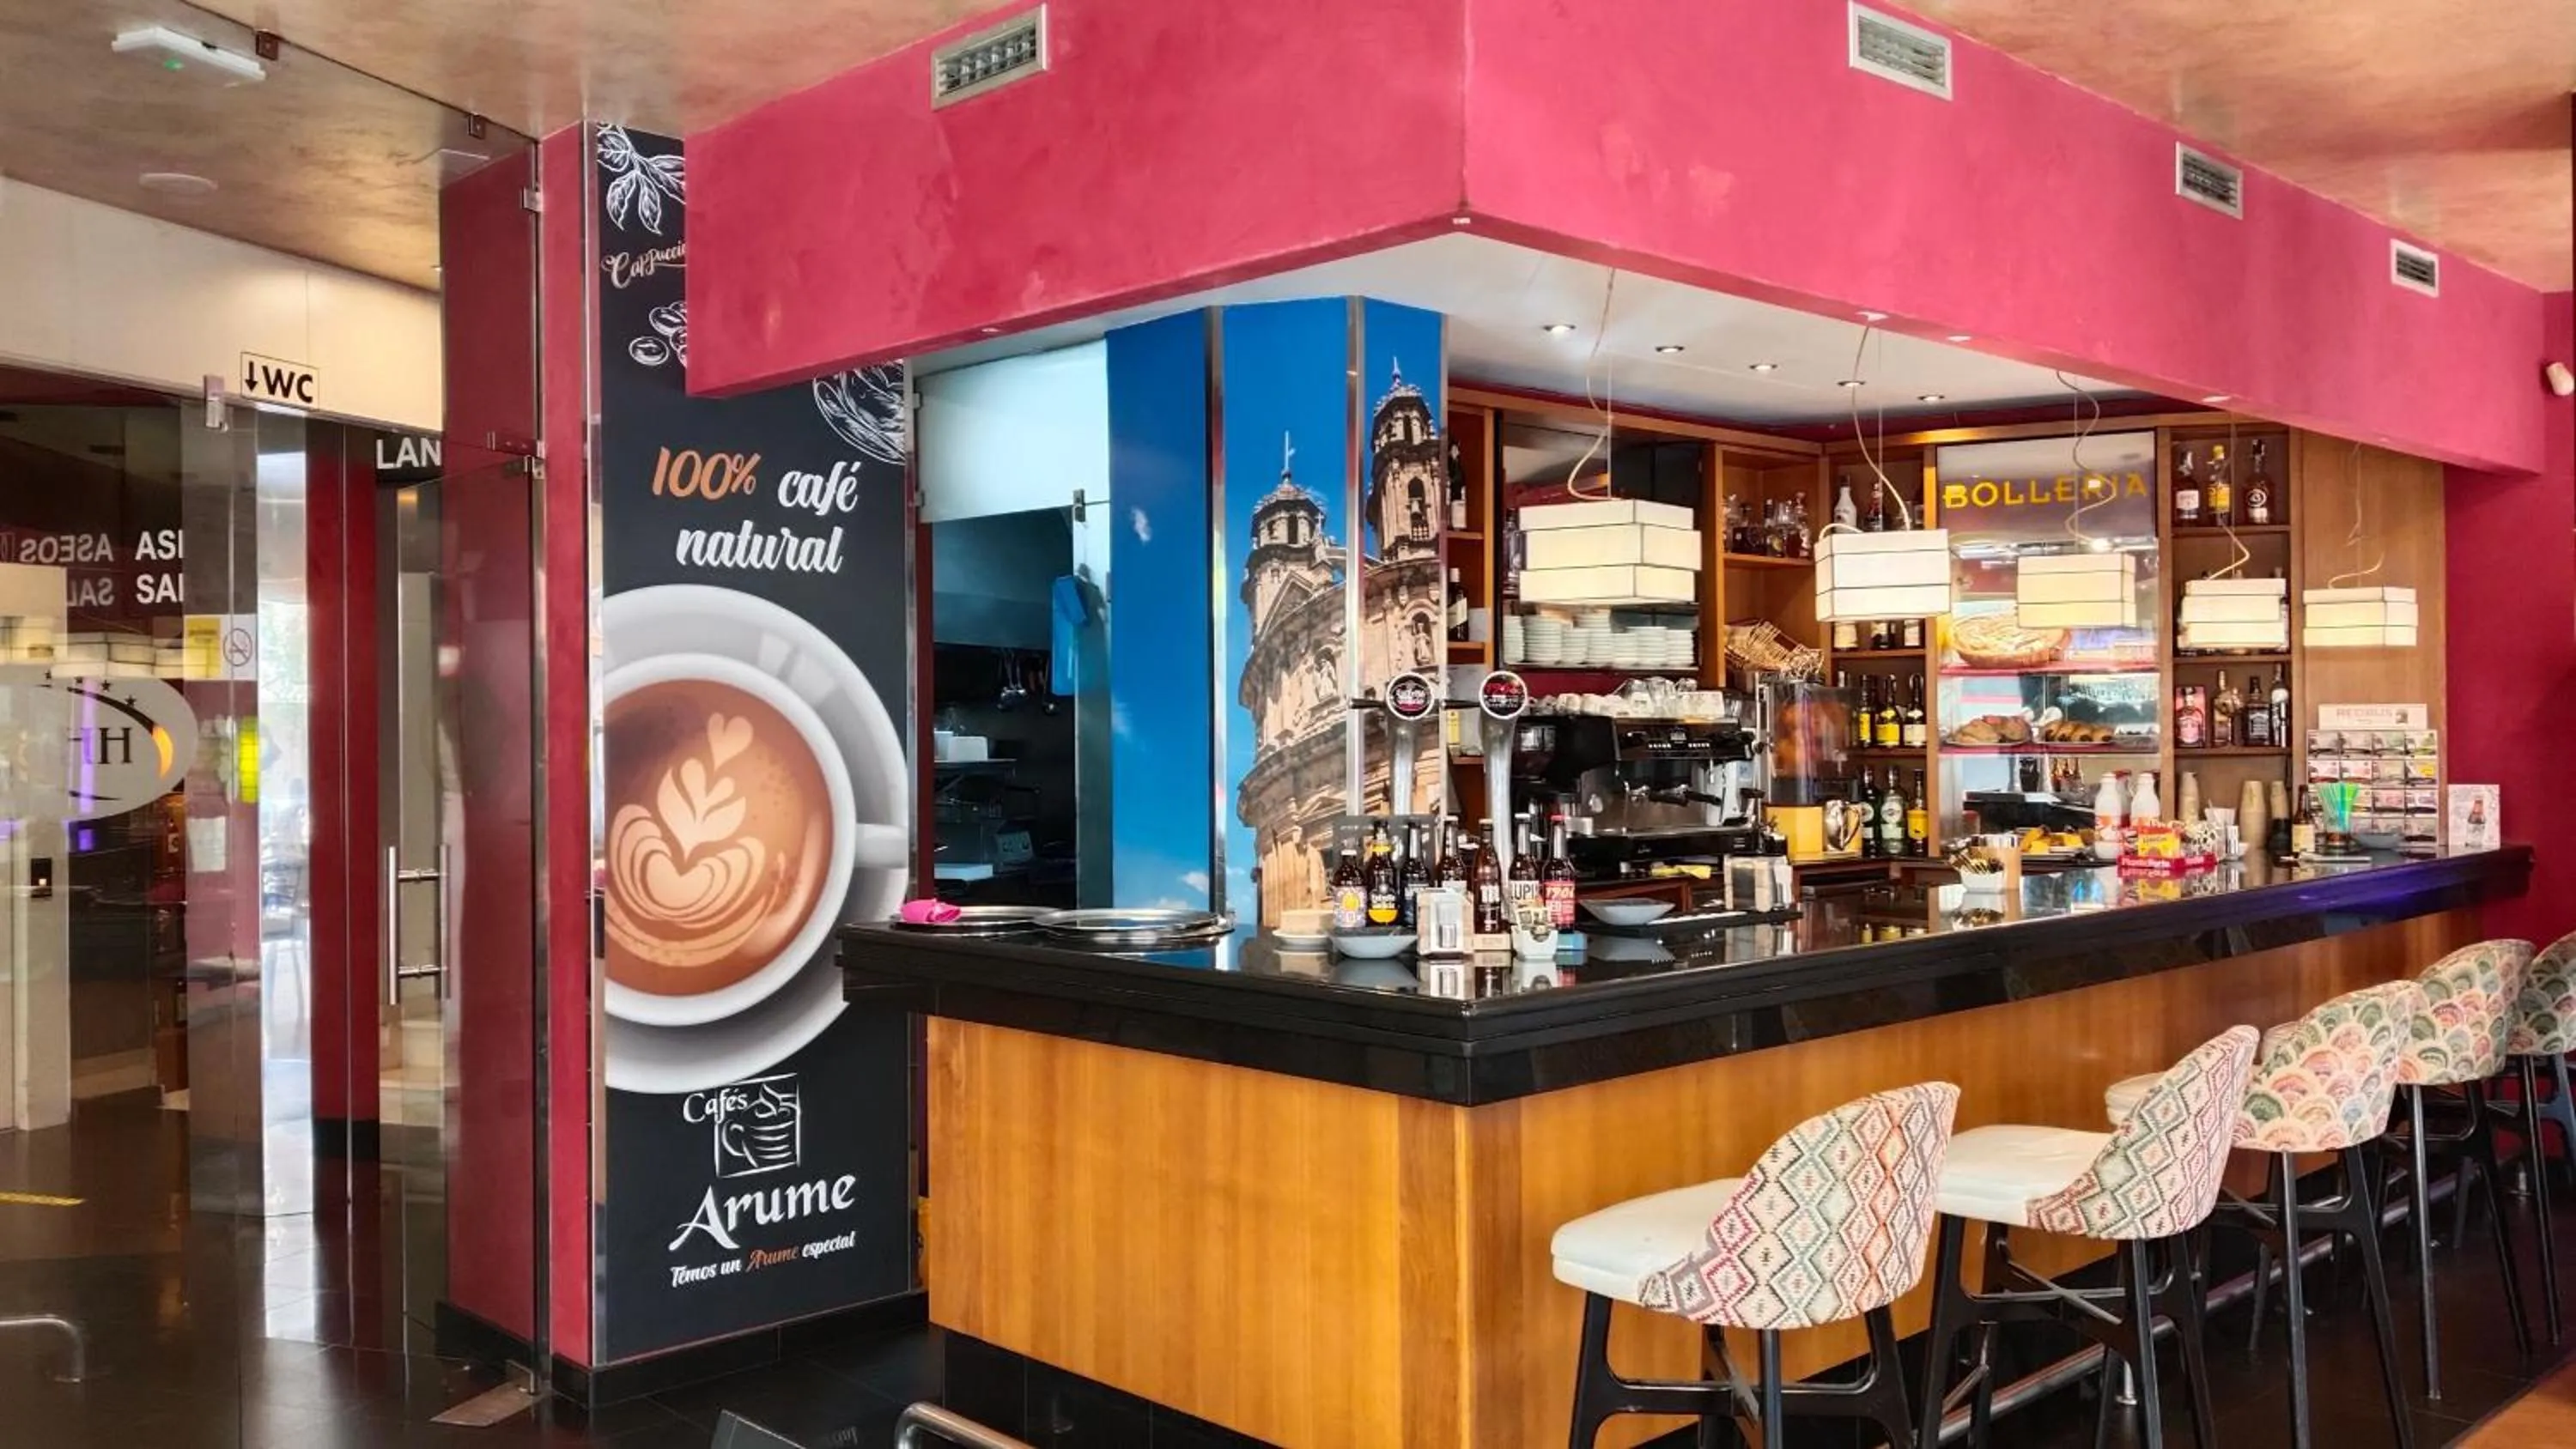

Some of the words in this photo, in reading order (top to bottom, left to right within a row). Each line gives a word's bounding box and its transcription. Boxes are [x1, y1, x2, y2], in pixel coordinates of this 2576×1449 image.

[261, 365, 313, 403] WC
[375, 437, 442, 470] LAN
[653, 446, 761, 500] 100%
[778, 461, 861, 515] café
[676, 519, 844, 573] natural
[683, 1088, 749, 1124] Cafés
[668, 1174, 856, 1252] Arume
[670, 1264, 718, 1288] Temos
[720, 1258, 742, 1276] un
[745, 1246, 799, 1272] Arume
[801, 1230, 856, 1259] especial
